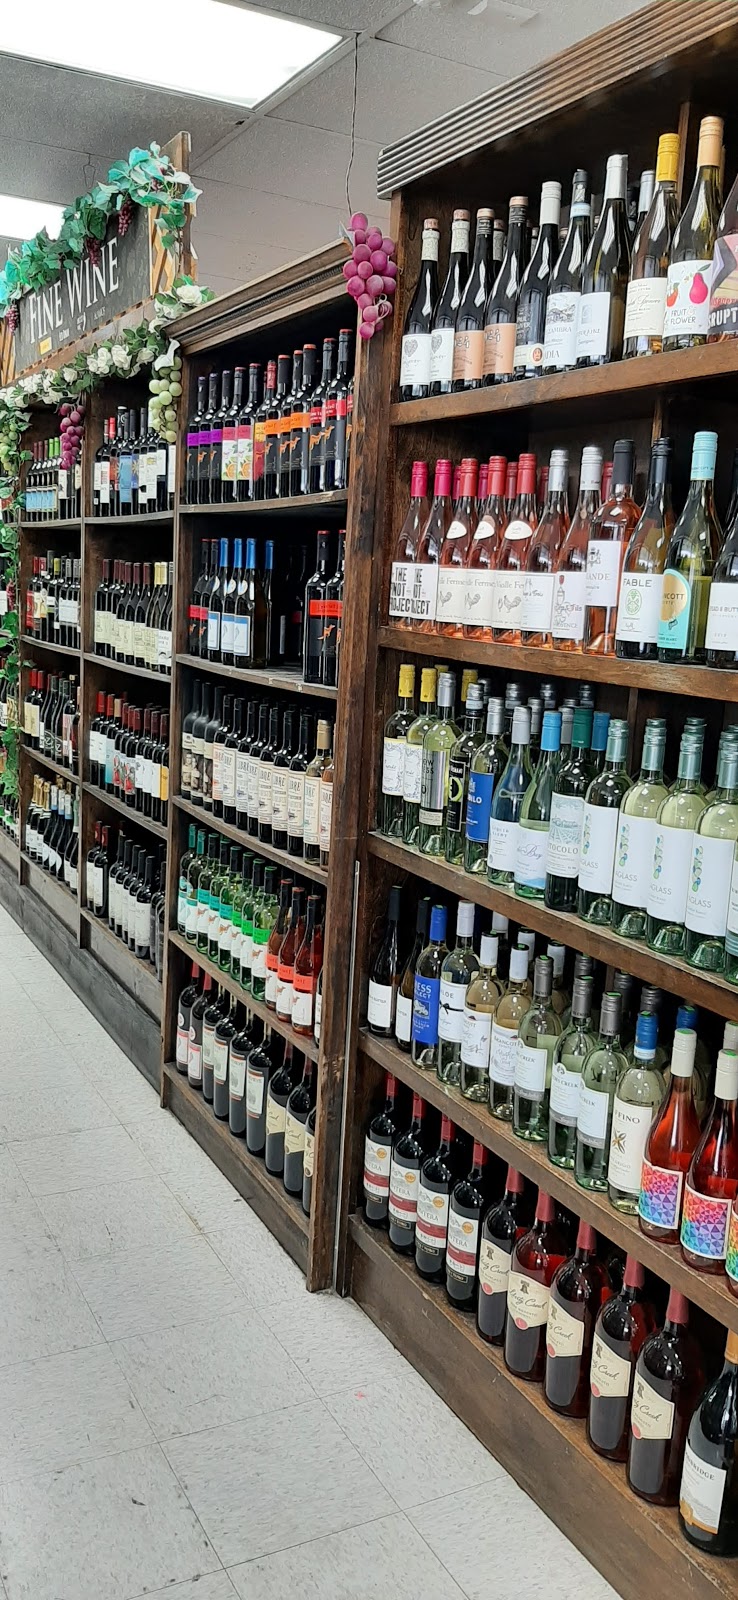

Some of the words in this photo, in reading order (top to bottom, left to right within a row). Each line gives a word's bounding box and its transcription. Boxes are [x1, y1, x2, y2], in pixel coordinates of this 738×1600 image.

[28, 280, 64, 344] FINE
[66, 237, 119, 318] WINE
[670, 316, 697, 325] FLOWER
[671, 309, 687, 317] FRUIT
[396, 567, 407, 581] THE
[553, 1326, 574, 1341] Creek
[597, 1364, 620, 1381] Creek
[639, 1405, 662, 1422] Creek
